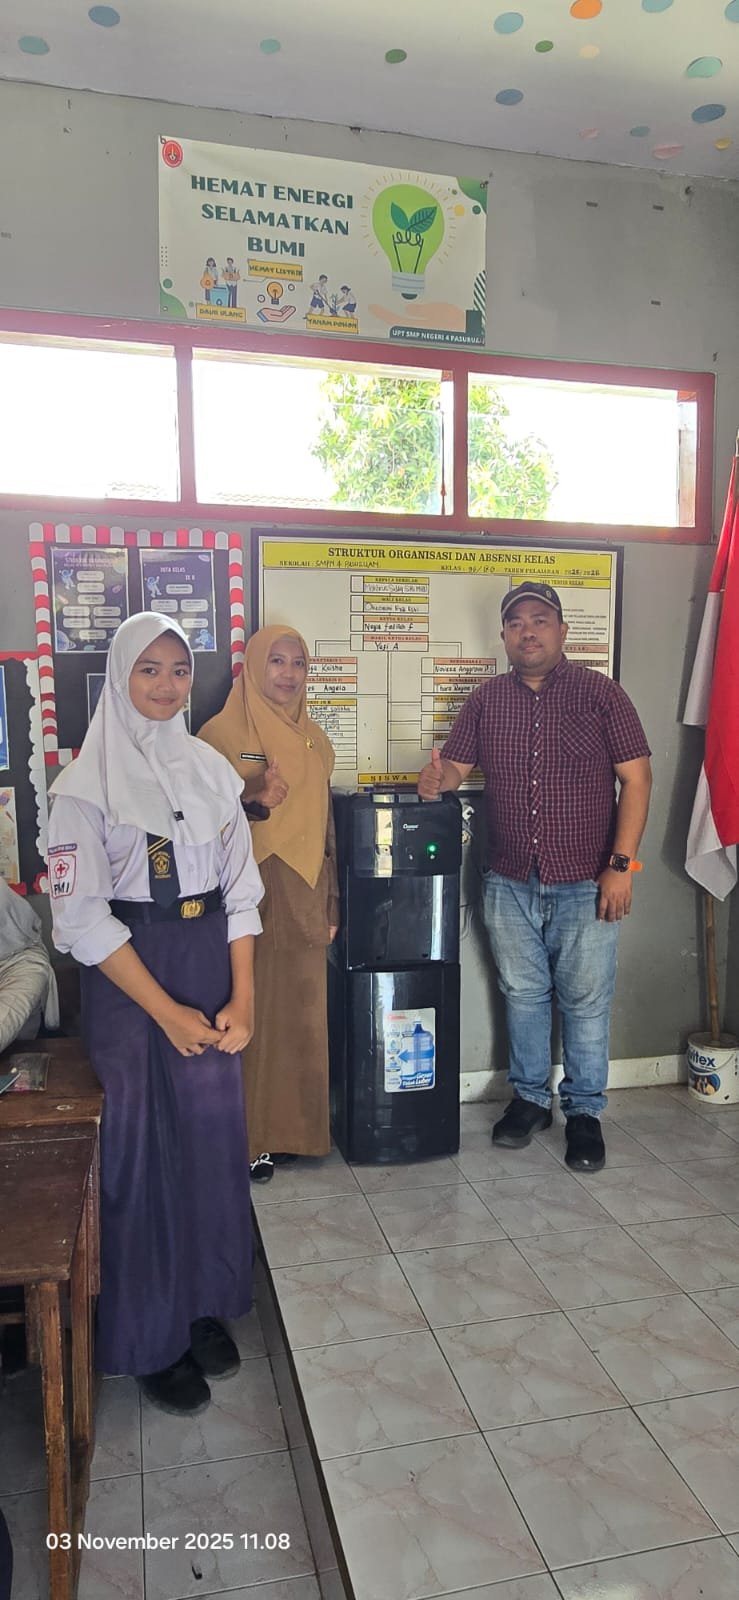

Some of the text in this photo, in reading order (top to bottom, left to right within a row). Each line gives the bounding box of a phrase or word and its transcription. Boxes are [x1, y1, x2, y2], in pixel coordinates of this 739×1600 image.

[191, 175, 354, 208] HEMAT ENERGI
[202, 204, 349, 235] SELAMATKAN
[248, 237, 305, 257] BUMI
[328, 548, 556, 564] STRUKTUR ORGANISASI DAN ABSENSI KELAS
